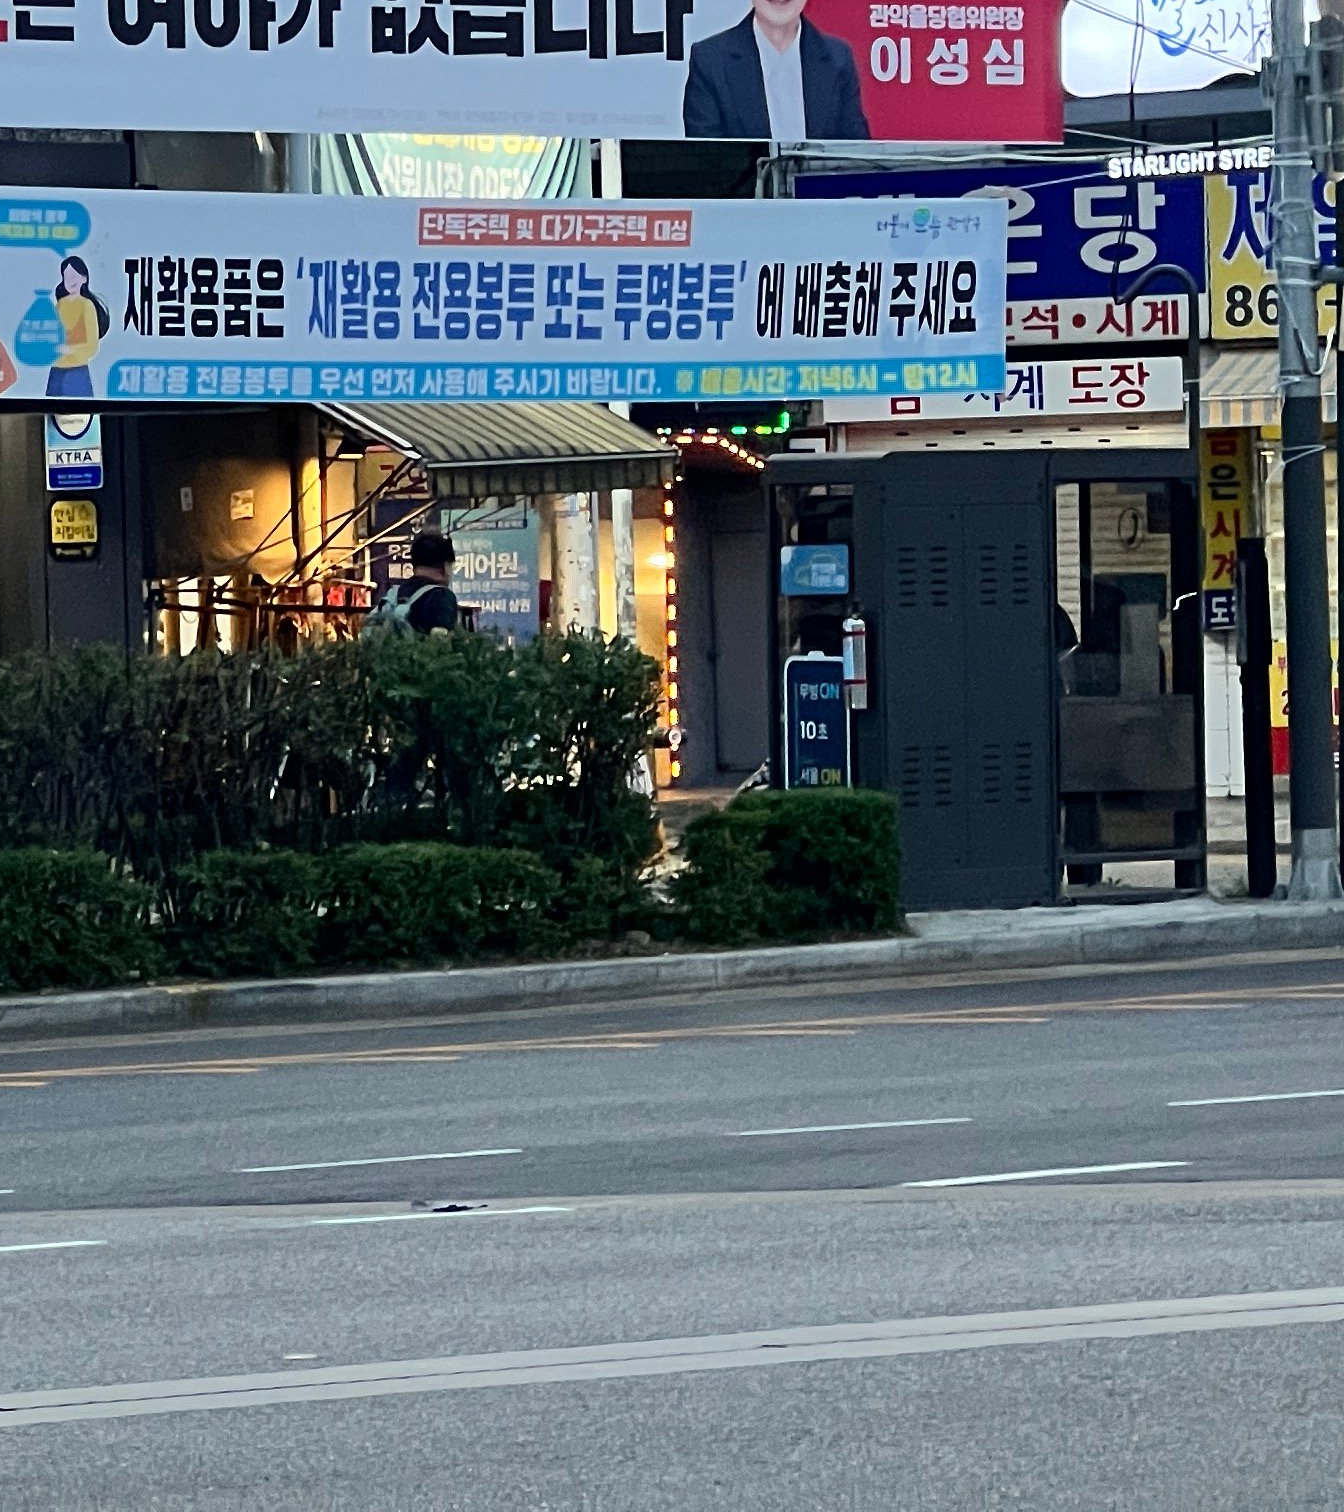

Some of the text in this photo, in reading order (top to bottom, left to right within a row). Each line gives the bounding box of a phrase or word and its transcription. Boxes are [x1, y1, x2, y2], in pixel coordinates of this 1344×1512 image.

[870, 36, 1024, 85] 이성심
[1108, 145, 1277, 179] STARLIGHT STRE
[423, 213, 510, 241] 단독주택
[516, 219, 535, 240] 및
[541, 214, 648, 242] 다가구주택
[123, 256, 284, 338] 재활용품은
[412, 261, 535, 340] 전용봉투
[544, 263, 604, 340] 또는
[793, 260, 882, 337] 배출해
[889, 260, 977, 336] 주세요
[118, 366, 188, 395] 재활용
[320, 368, 365, 396] 우선
[371, 368, 415, 396] 먼저
[494, 367, 559, 396] 주시기
[1068, 360, 1150, 409] 도장
